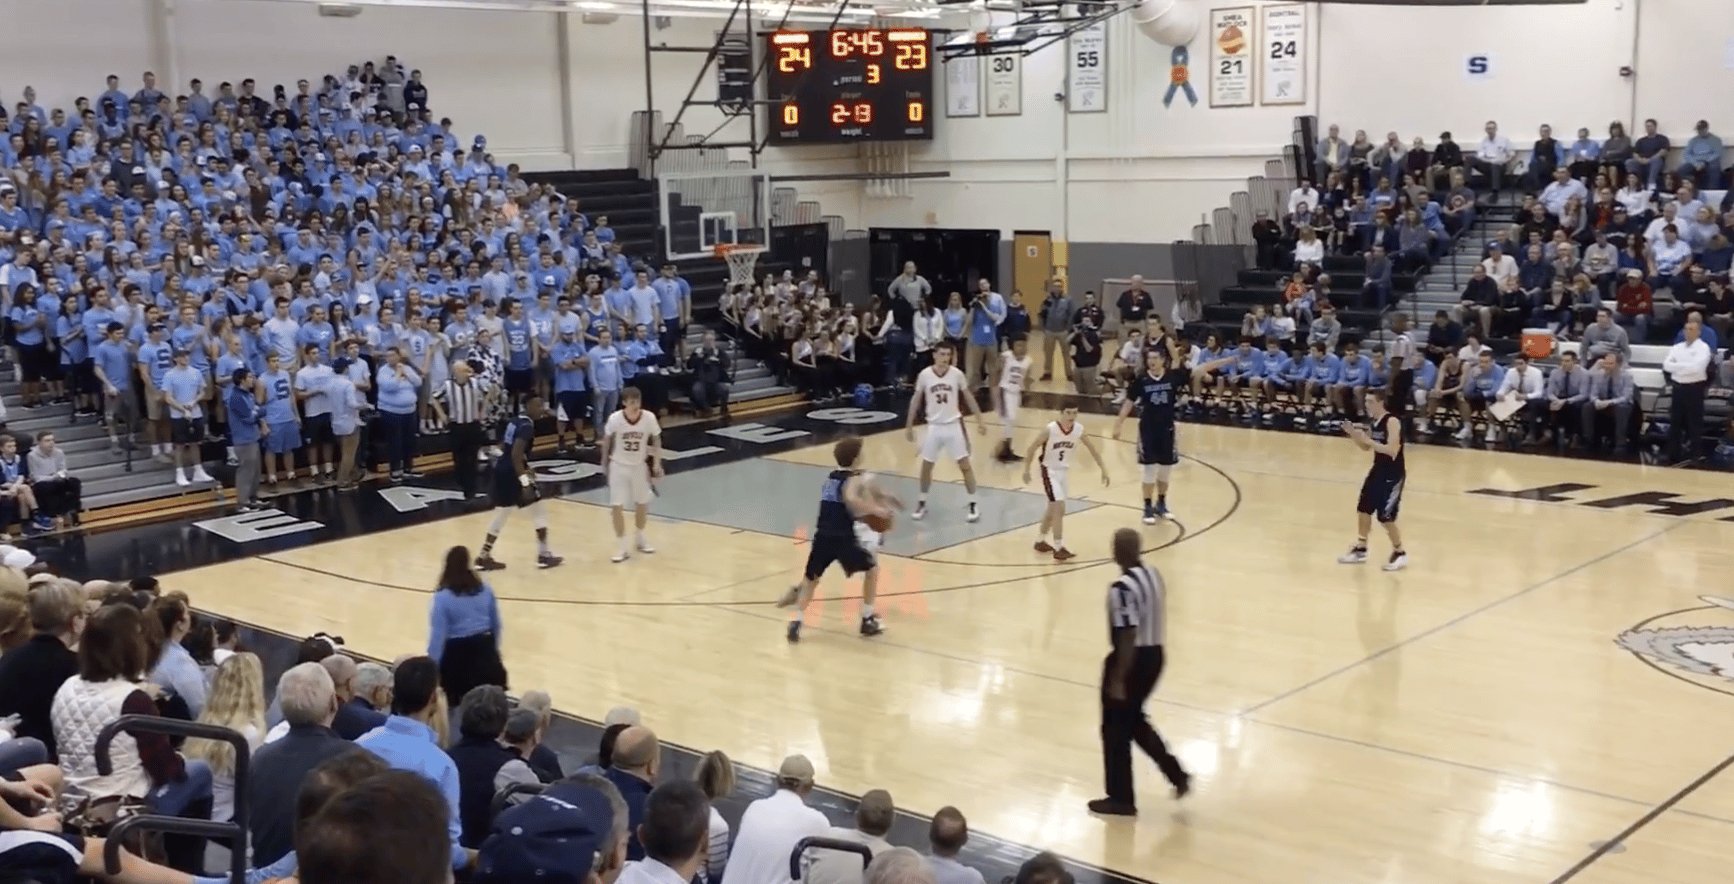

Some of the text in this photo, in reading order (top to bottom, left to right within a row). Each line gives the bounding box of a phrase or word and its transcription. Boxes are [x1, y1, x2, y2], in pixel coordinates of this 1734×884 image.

[832, 31, 883, 56] 6:45
[1271, 41, 1296, 59] 24
[780, 47, 811, 72] 24
[896, 45, 927, 69] 23
[993, 57, 1014, 72] 30
[1077, 51, 1099, 67] 55
[1468, 56, 1488, 74] S
[867, 64, 881, 84] 3
[1221, 60, 1242, 74] 21
[784, 105, 799, 124] 0
[909, 103, 922, 121] 0
[275, 378, 290, 400] S
[936, 393, 949, 404] 34
[624, 441, 640, 452] 33
[1058, 450, 1065, 461] 5
